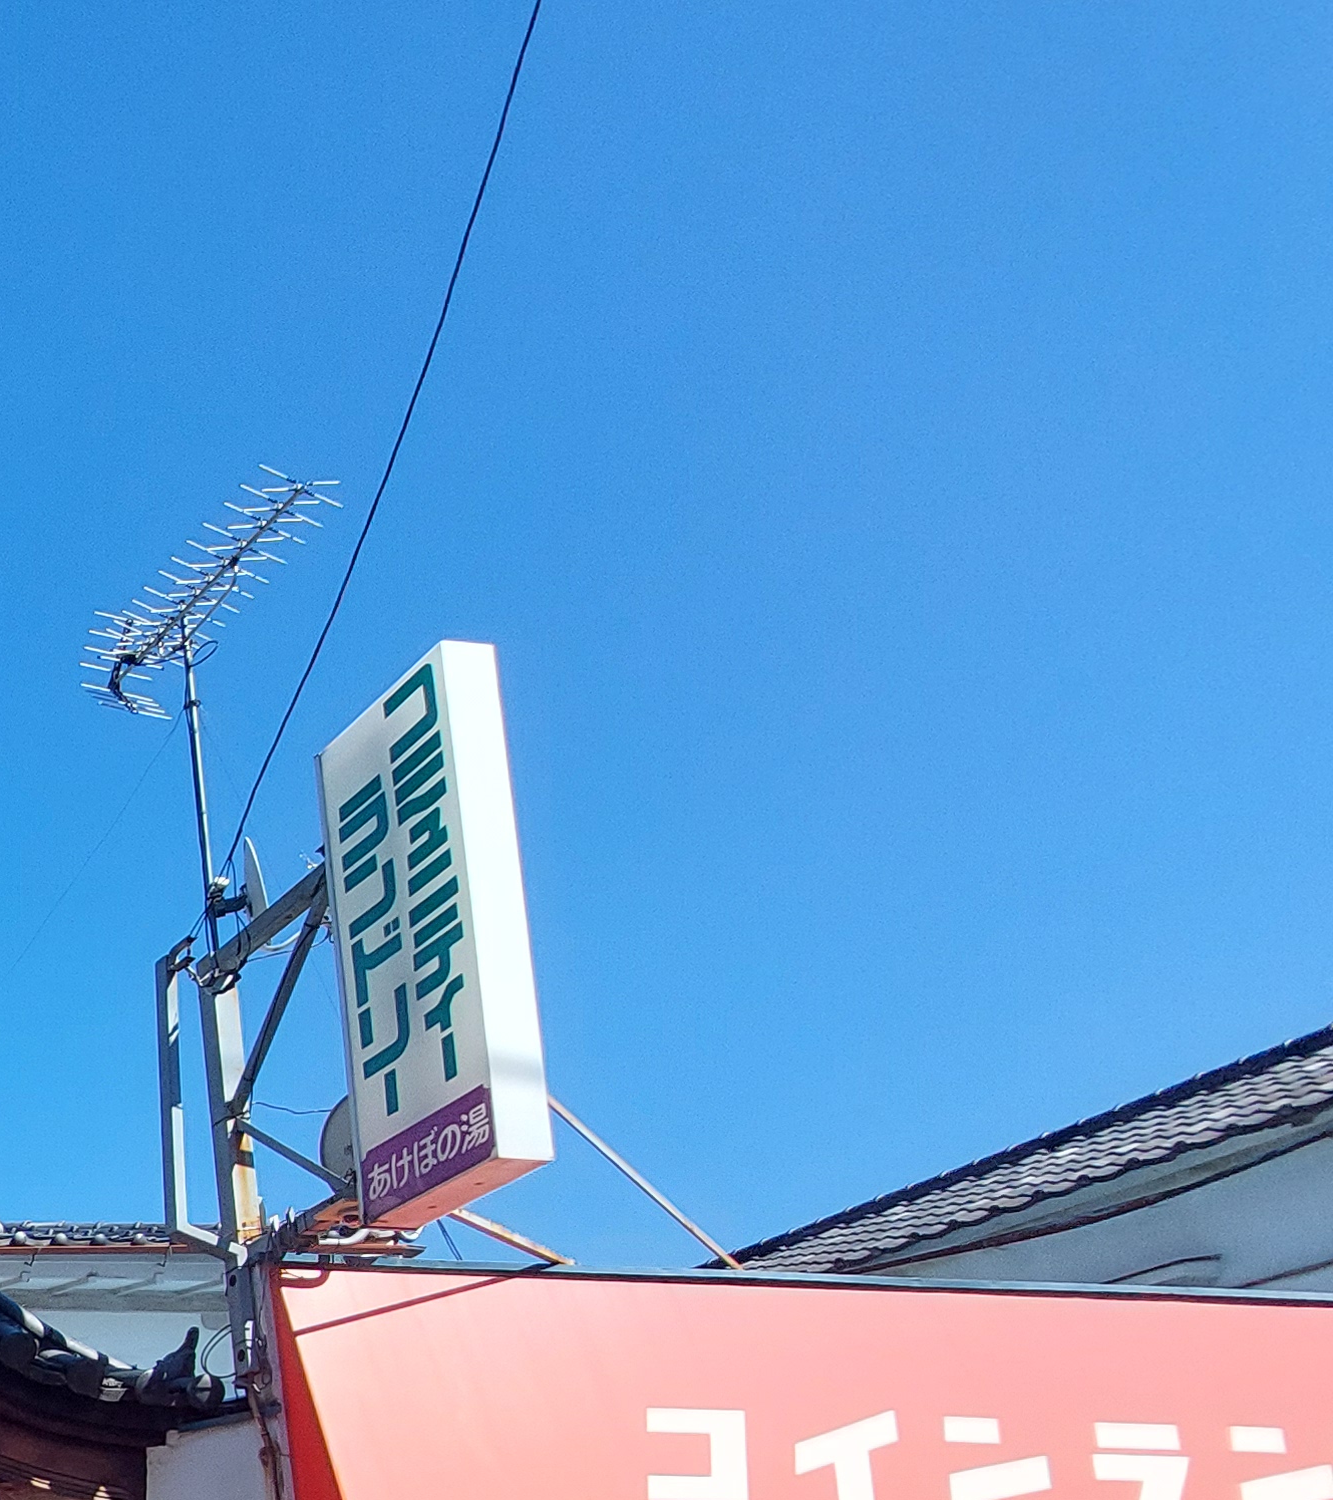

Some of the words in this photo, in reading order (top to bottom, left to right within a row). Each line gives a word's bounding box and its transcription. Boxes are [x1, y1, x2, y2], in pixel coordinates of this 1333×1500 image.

[338, 773, 410, 1117] ランドリー
[383, 662, 464, 1082] コミュニティー
[366, 1102, 492, 1201] あけぼの湯
